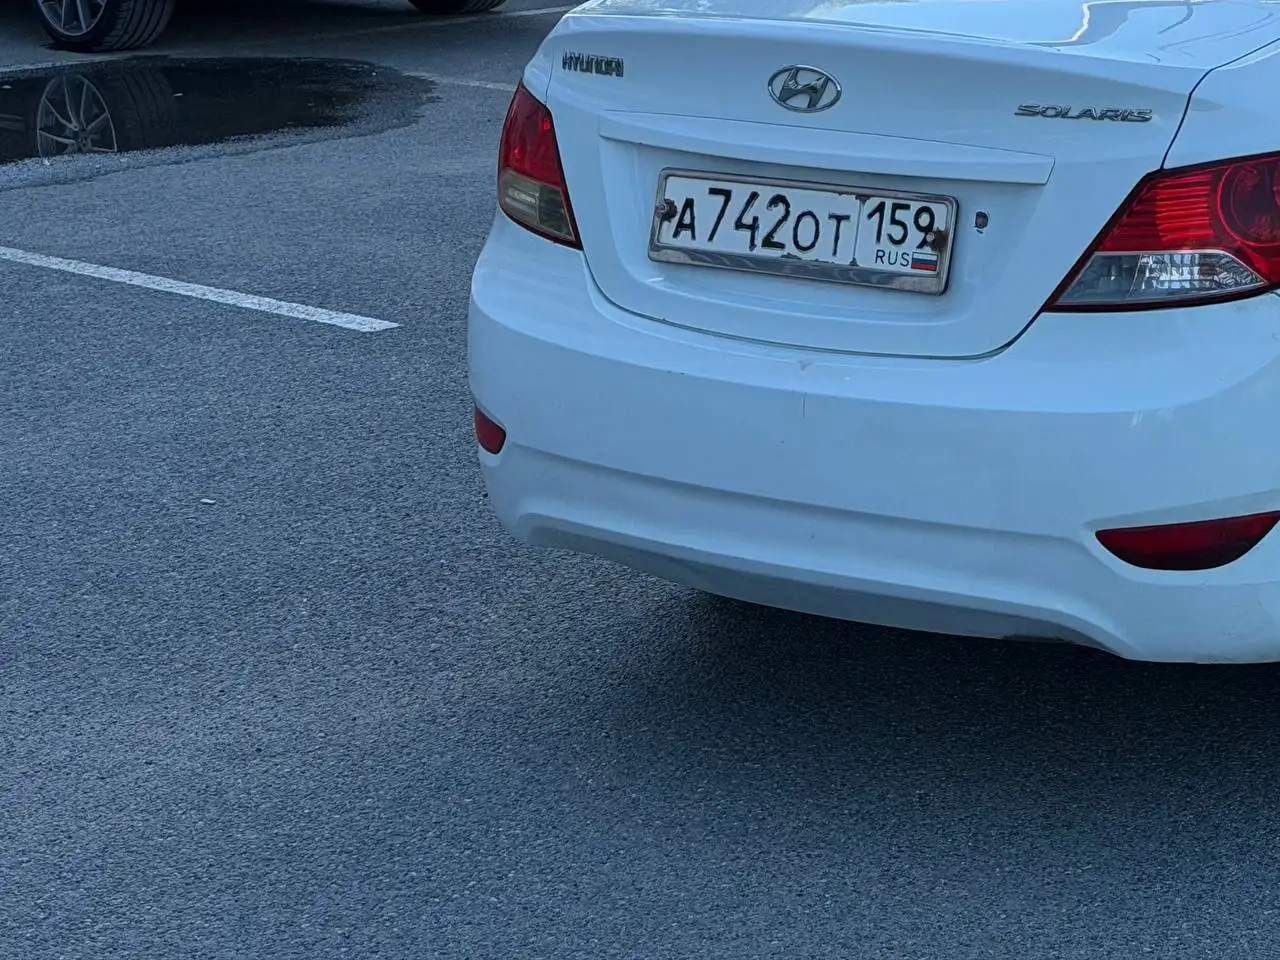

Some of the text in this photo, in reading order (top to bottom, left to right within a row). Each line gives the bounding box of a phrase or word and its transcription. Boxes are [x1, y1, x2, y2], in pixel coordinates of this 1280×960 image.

[562, 51, 624, 78] HYUNDAI
[1014, 103, 1153, 123] SOLARIS
[672, 187, 937, 252] А742ОТ 159
[875, 249, 910, 268] RUS
